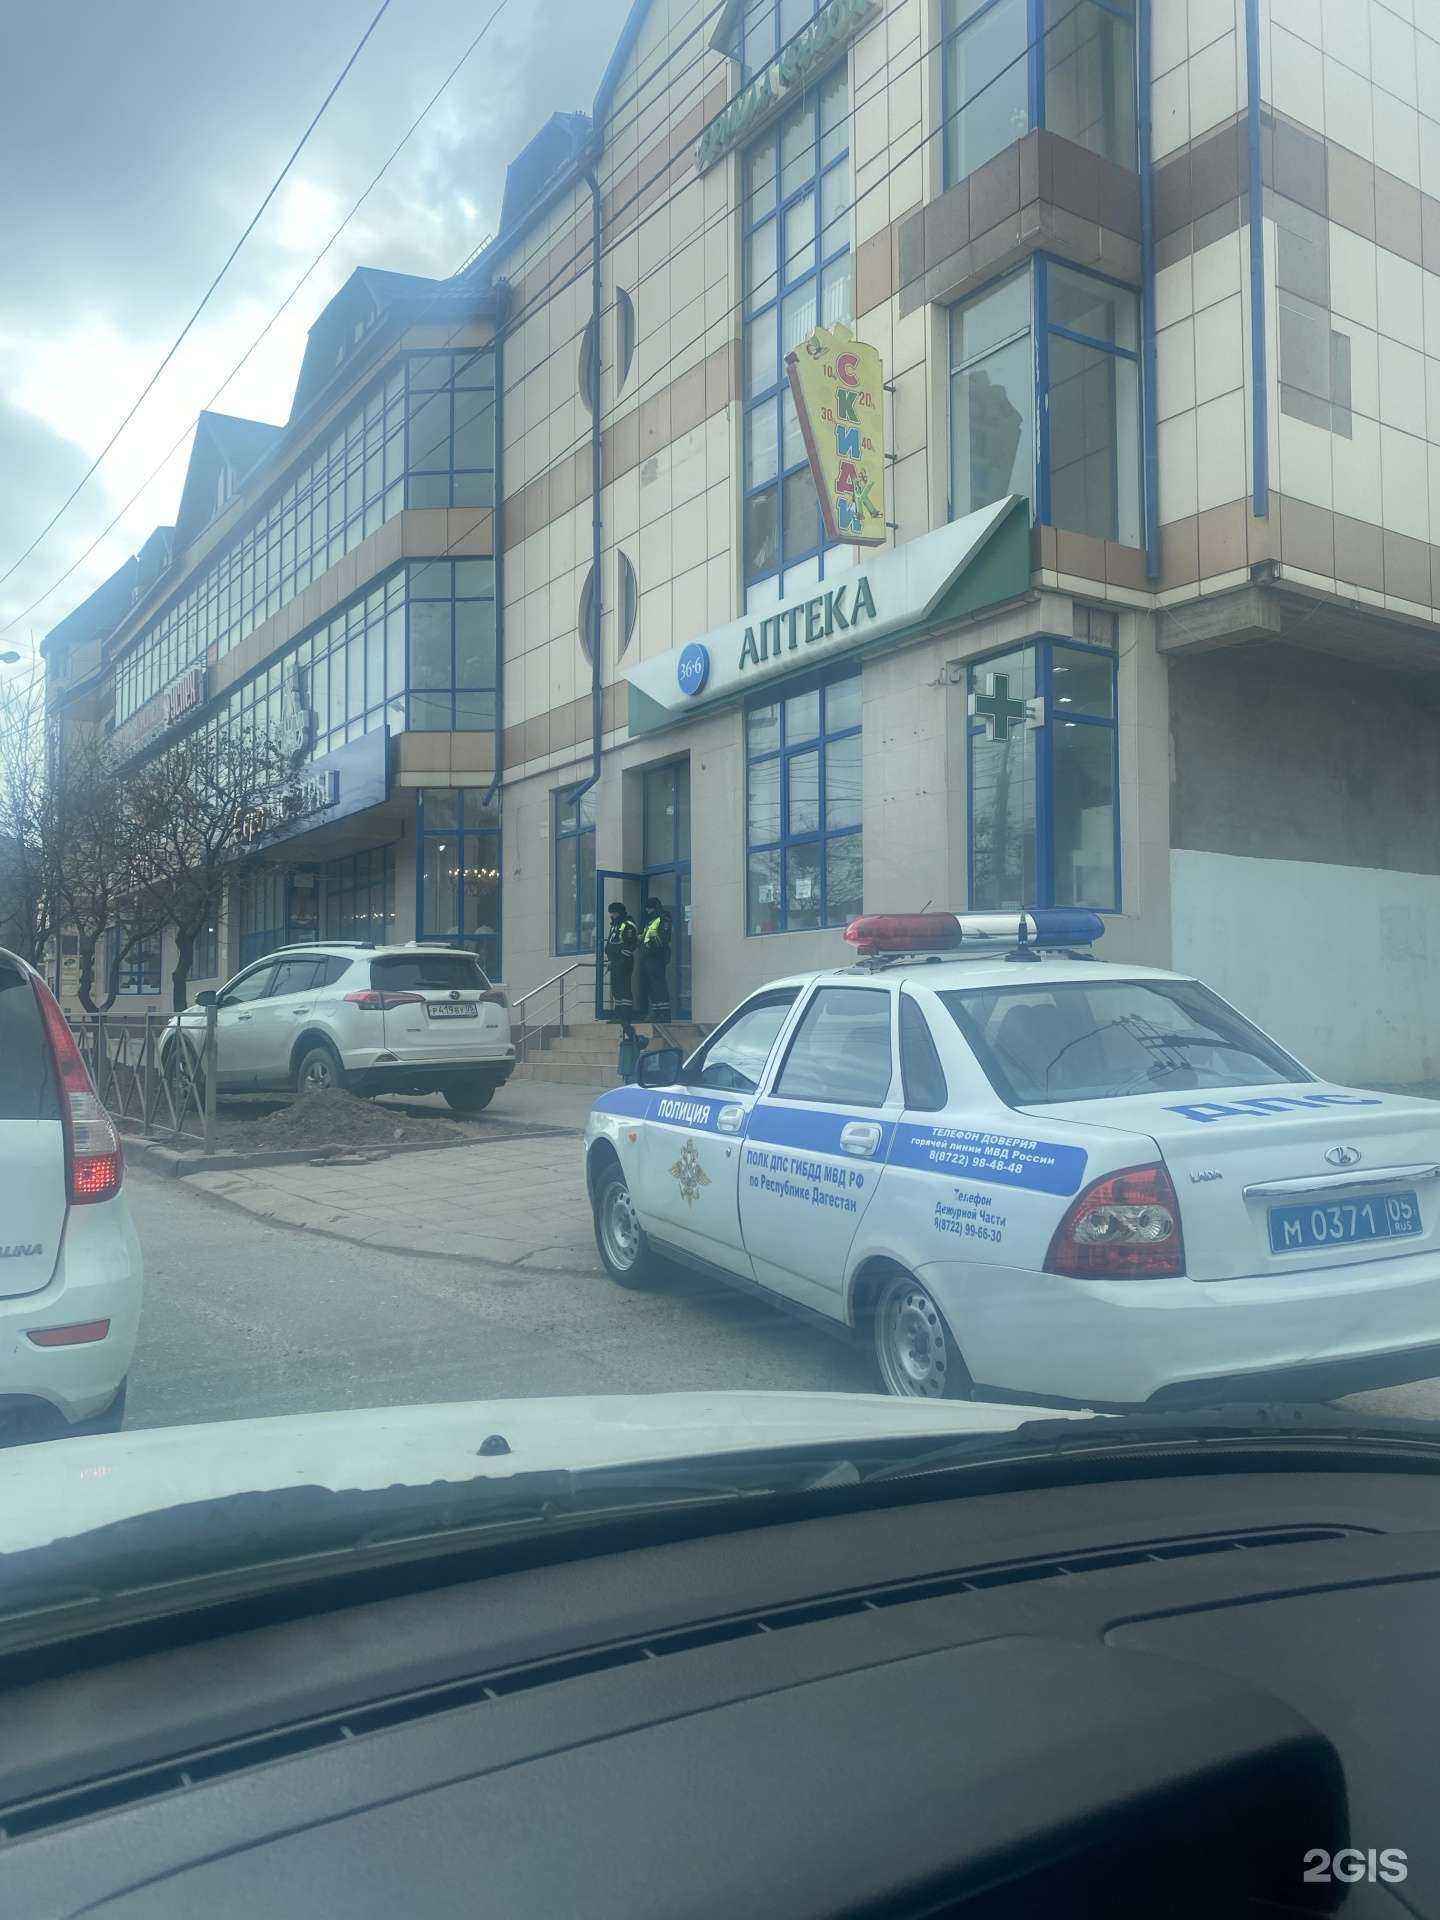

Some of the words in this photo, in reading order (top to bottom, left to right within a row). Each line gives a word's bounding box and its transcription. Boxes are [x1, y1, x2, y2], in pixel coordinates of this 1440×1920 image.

[738, 576, 877, 670] АПТЕКА
[657, 1099, 711, 1126] ПОЛИЦИЯ
[1161, 1094, 1383, 1123] ДПС
[911, 1137, 948, 1150] горячей
[950, 1142, 981, 1154] линии
[984, 1146, 1009, 1159] МВД
[1011, 1151, 1056, 1165] России
[932, 1127, 980, 1142] ТЕЛЕФОН
[981, 1134, 1038, 1150] ДОВЕРИЯ
[746, 1150, 769, 1168] ПОЛК
[770, 1155, 789, 1173] ДПС
[790, 1158, 822, 1182] ГИБДД
[824, 1166, 846, 1189] МВД
[848, 1169, 865, 1189] РФ
[929, 1150, 969, 1167] 8(8722)
[972, 1157, 1024, 1174] 98-48-48
[749, 1175, 758, 1187] по
[760, 1174, 810, 1199] Республике
[811, 1187, 857, 1212] Дагестан
[934, 1202, 977, 1220] Дежурной
[979, 1209, 1006, 1227] Части
[1310, 1204, 1377, 1241] 0371
[1389, 1199, 1413, 1221] 05
[1394, 1221, 1413, 1233] RUS
[965, 1223, 1002, 1242] 99-66-30
[0, 1243, 43, 1257] LINA
